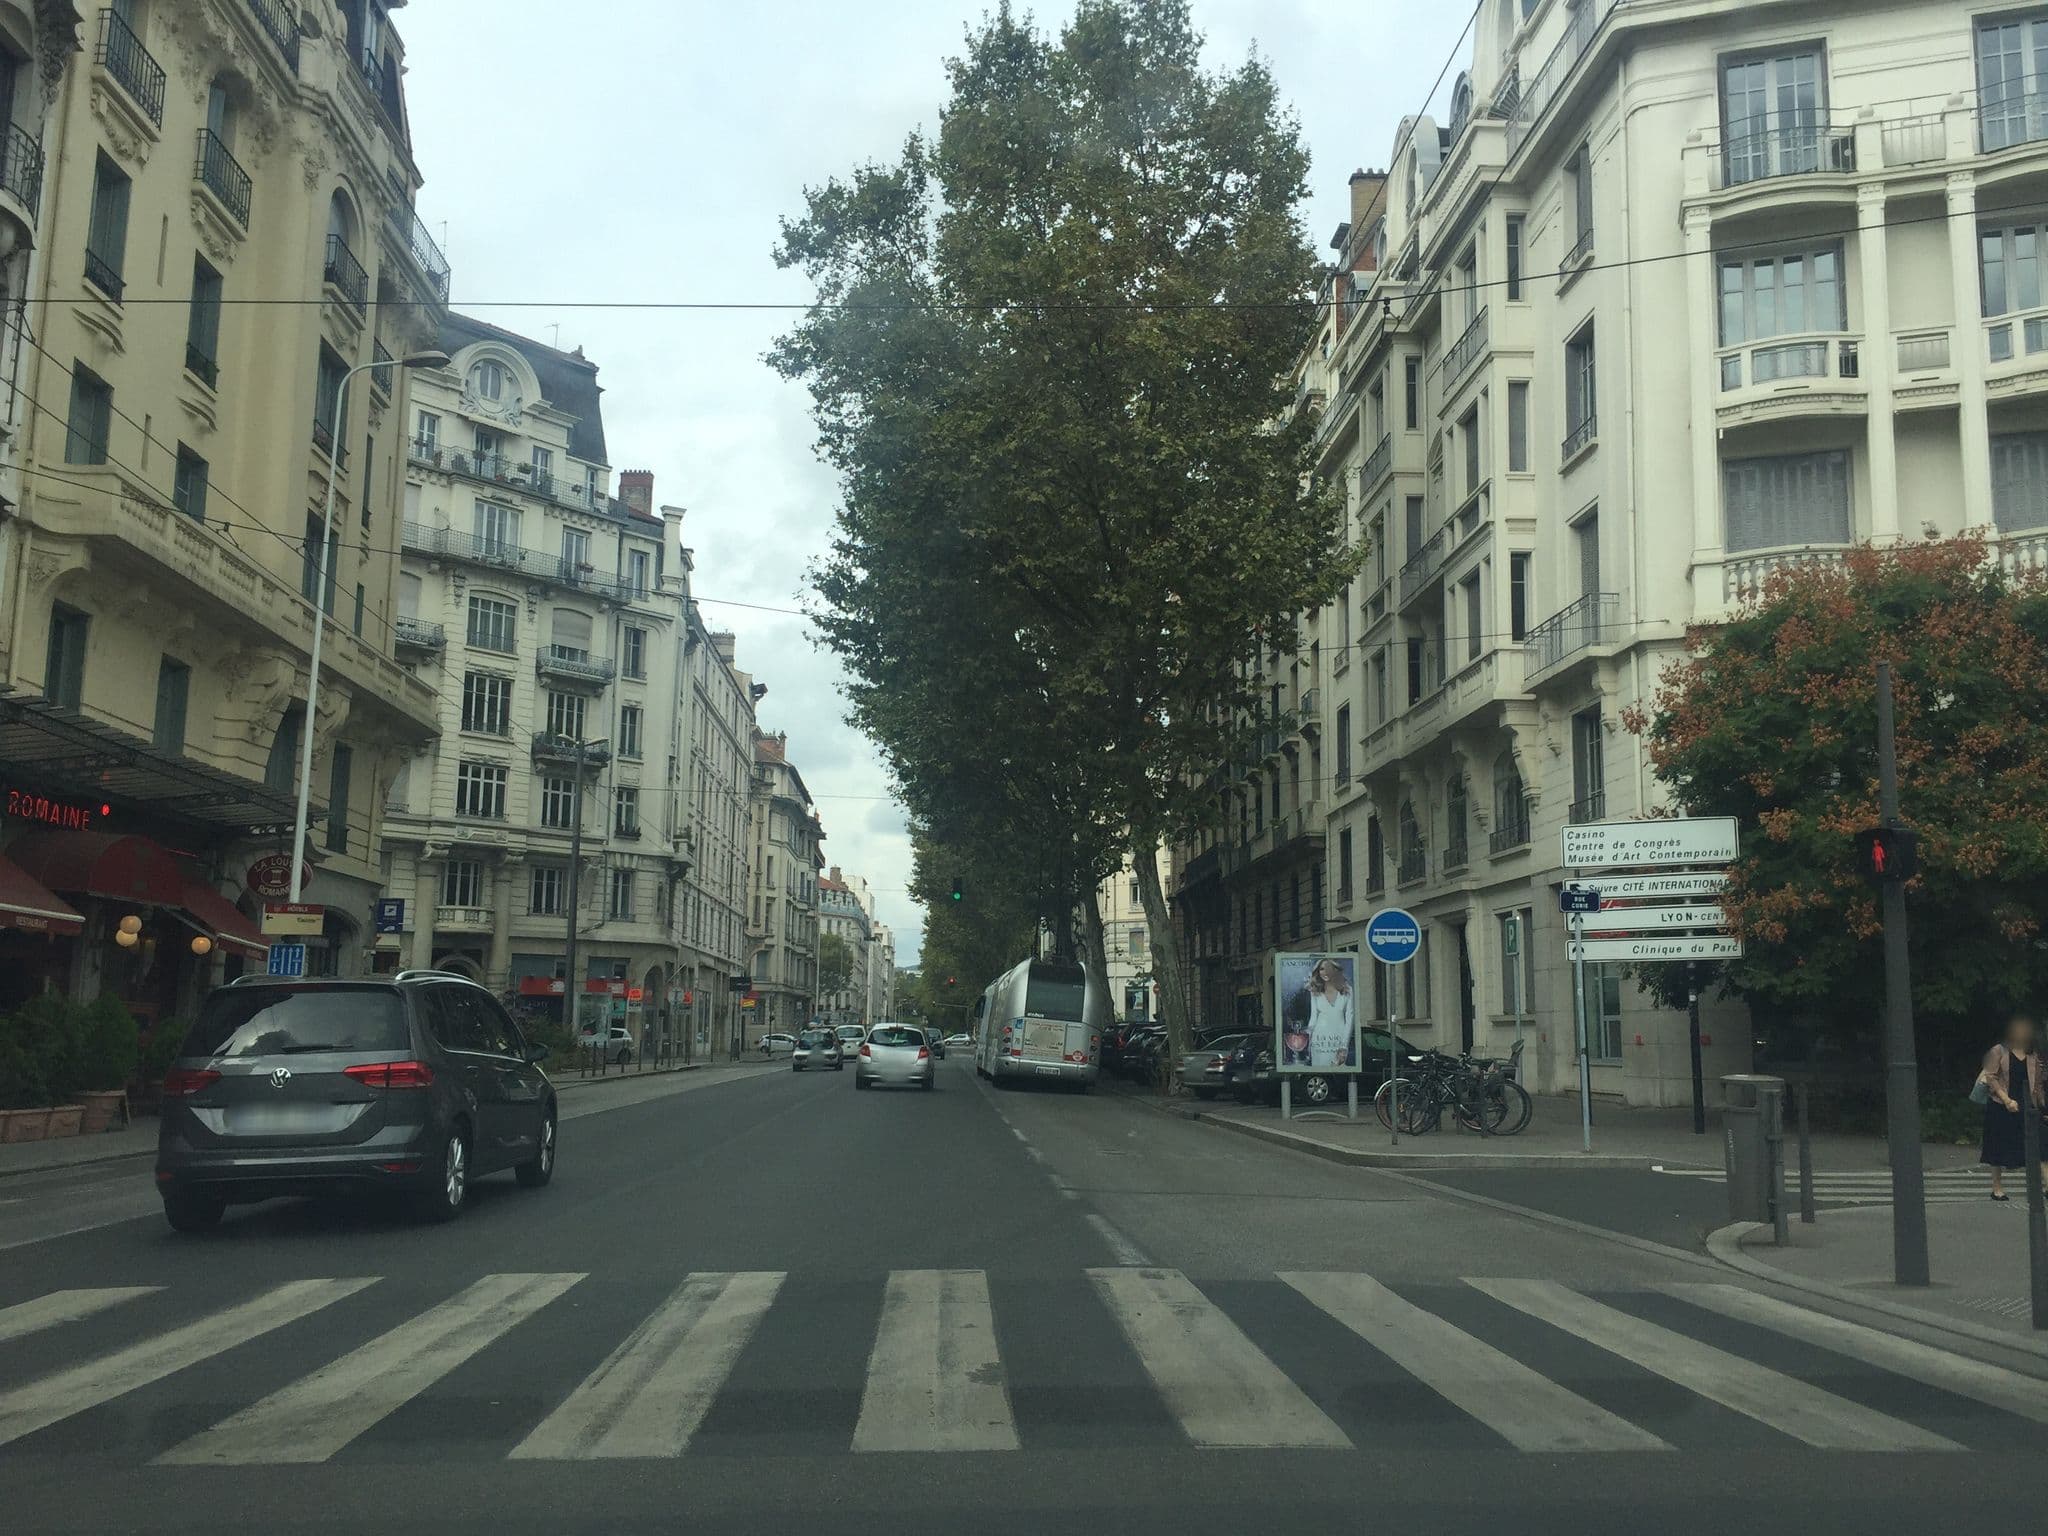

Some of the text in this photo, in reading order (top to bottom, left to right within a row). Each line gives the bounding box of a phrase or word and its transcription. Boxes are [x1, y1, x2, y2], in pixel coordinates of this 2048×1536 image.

[8, 791, 91, 831] ROMAINE
[1567, 831, 1605, 840] Casino
[1568, 838, 1682, 852] Centre de Congrès
[1568, 848, 1733, 863] Musée d'Art Contemporain
[255, 860, 267, 872] LA
[1588, 882, 1619, 895] Suivre
[1623, 880, 1645, 892] CITÉ
[1508, 925, 1515, 947] P
[1632, 942, 1739, 956] Clinique du Parc
